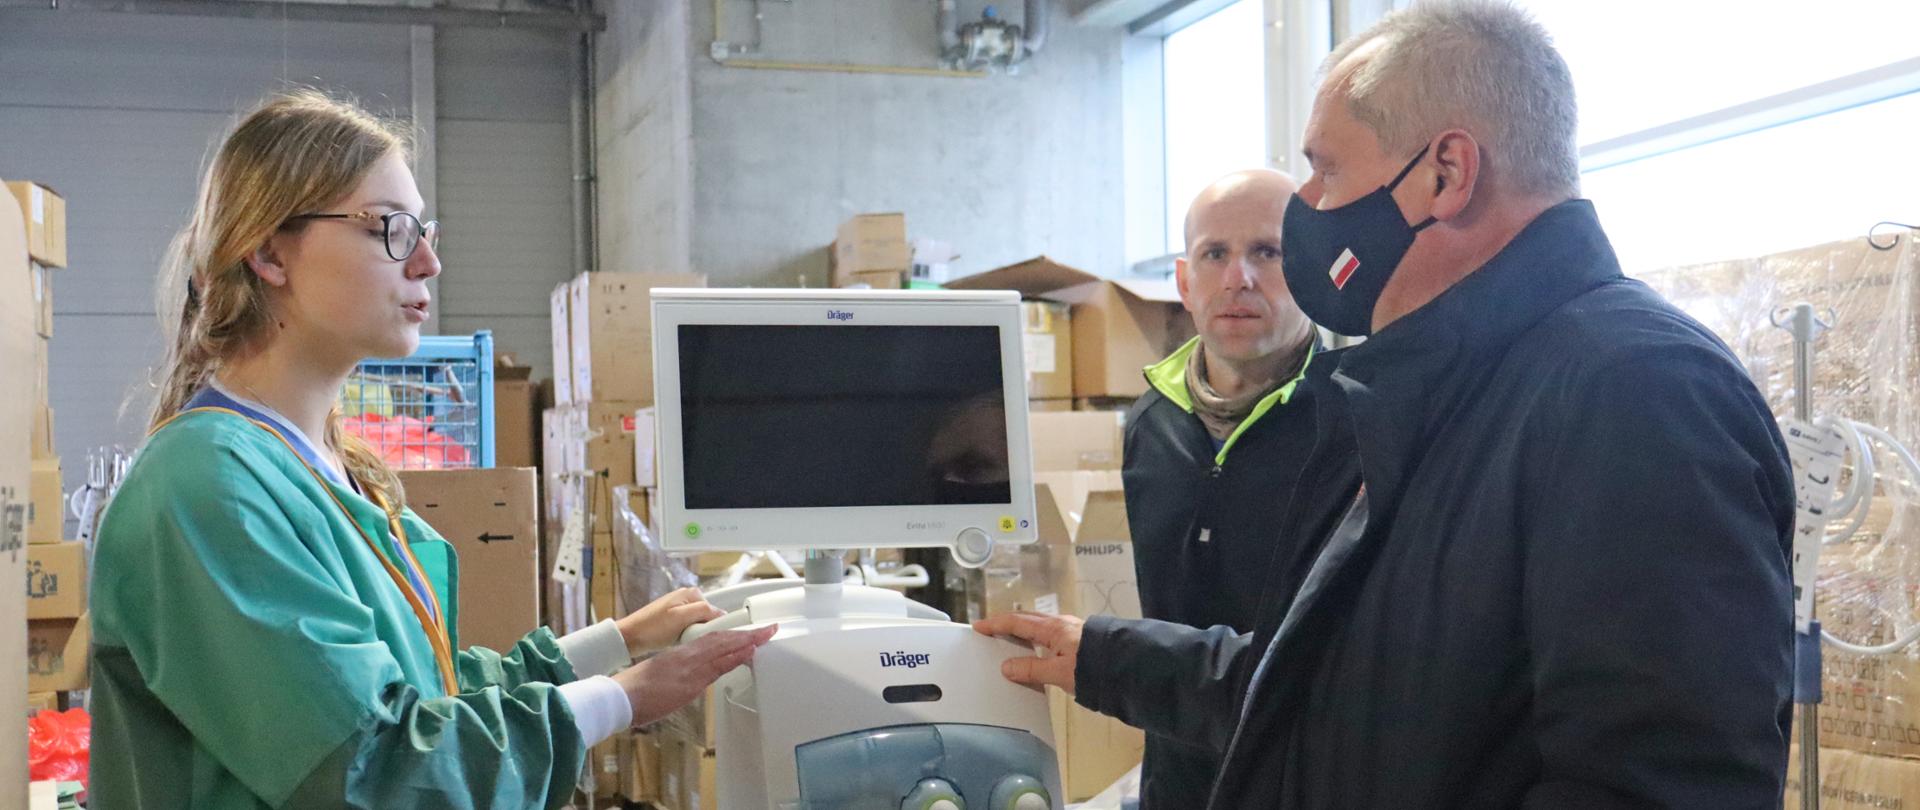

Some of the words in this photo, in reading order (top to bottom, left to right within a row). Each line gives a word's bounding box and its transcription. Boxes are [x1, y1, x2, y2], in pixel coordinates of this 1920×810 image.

[827, 310, 854, 321] Dräger
[1075, 544, 1124, 556] PHILIPS
[880, 651, 930, 668] Dräger
